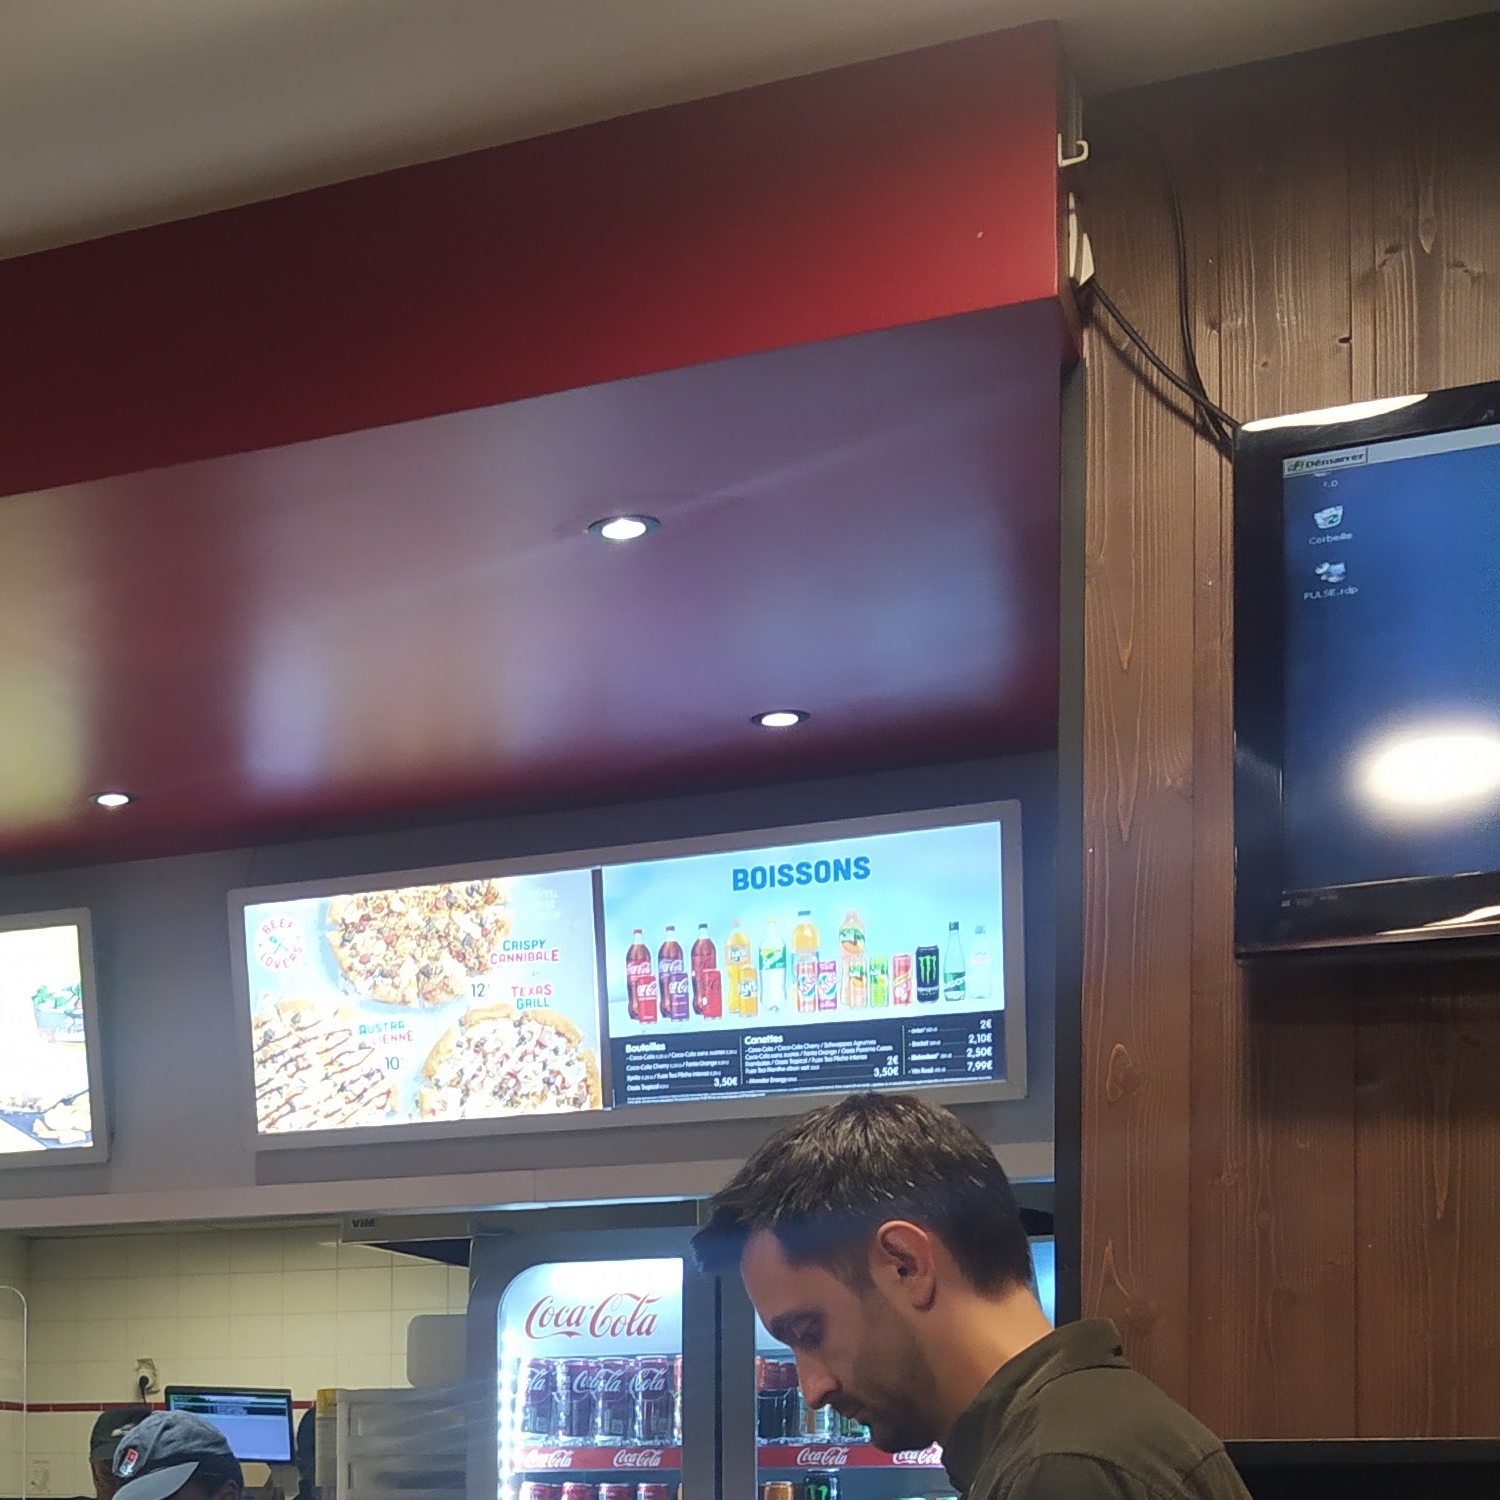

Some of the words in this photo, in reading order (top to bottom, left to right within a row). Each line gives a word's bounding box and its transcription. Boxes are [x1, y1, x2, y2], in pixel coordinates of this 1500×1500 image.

[1305, 452, 1365, 469] Démarrer
[732, 855, 871, 891] BOISSONS
[502, 938, 548, 951] CRISPY
[260, 946, 303, 969] LOVERS
[490, 949, 560, 965] CANNIBALE
[511, 984, 553, 998] TEXAS
[516, 998, 551, 1010] GRILL
[980, 1019, 992, 1029] 2€
[744, 1035, 783, 1045] Canettes
[968, 1033, 993, 1045] 2,10€
[625, 1042, 667, 1054] Bouteilles
[966, 1046, 993, 1058] 2,50€
[886, 1055, 899, 1066] 2€
[967, 1060, 993, 1072] 7,99€
[873, 1066, 899, 1078] 3,50€
[713, 1077, 738, 1088] 3,50€
[525, 1292, 663, 1340] Coca-Cola
[612, 1449, 664, 1468] Coca-Cola
[796, 1447, 850, 1466] Coca-Cola
